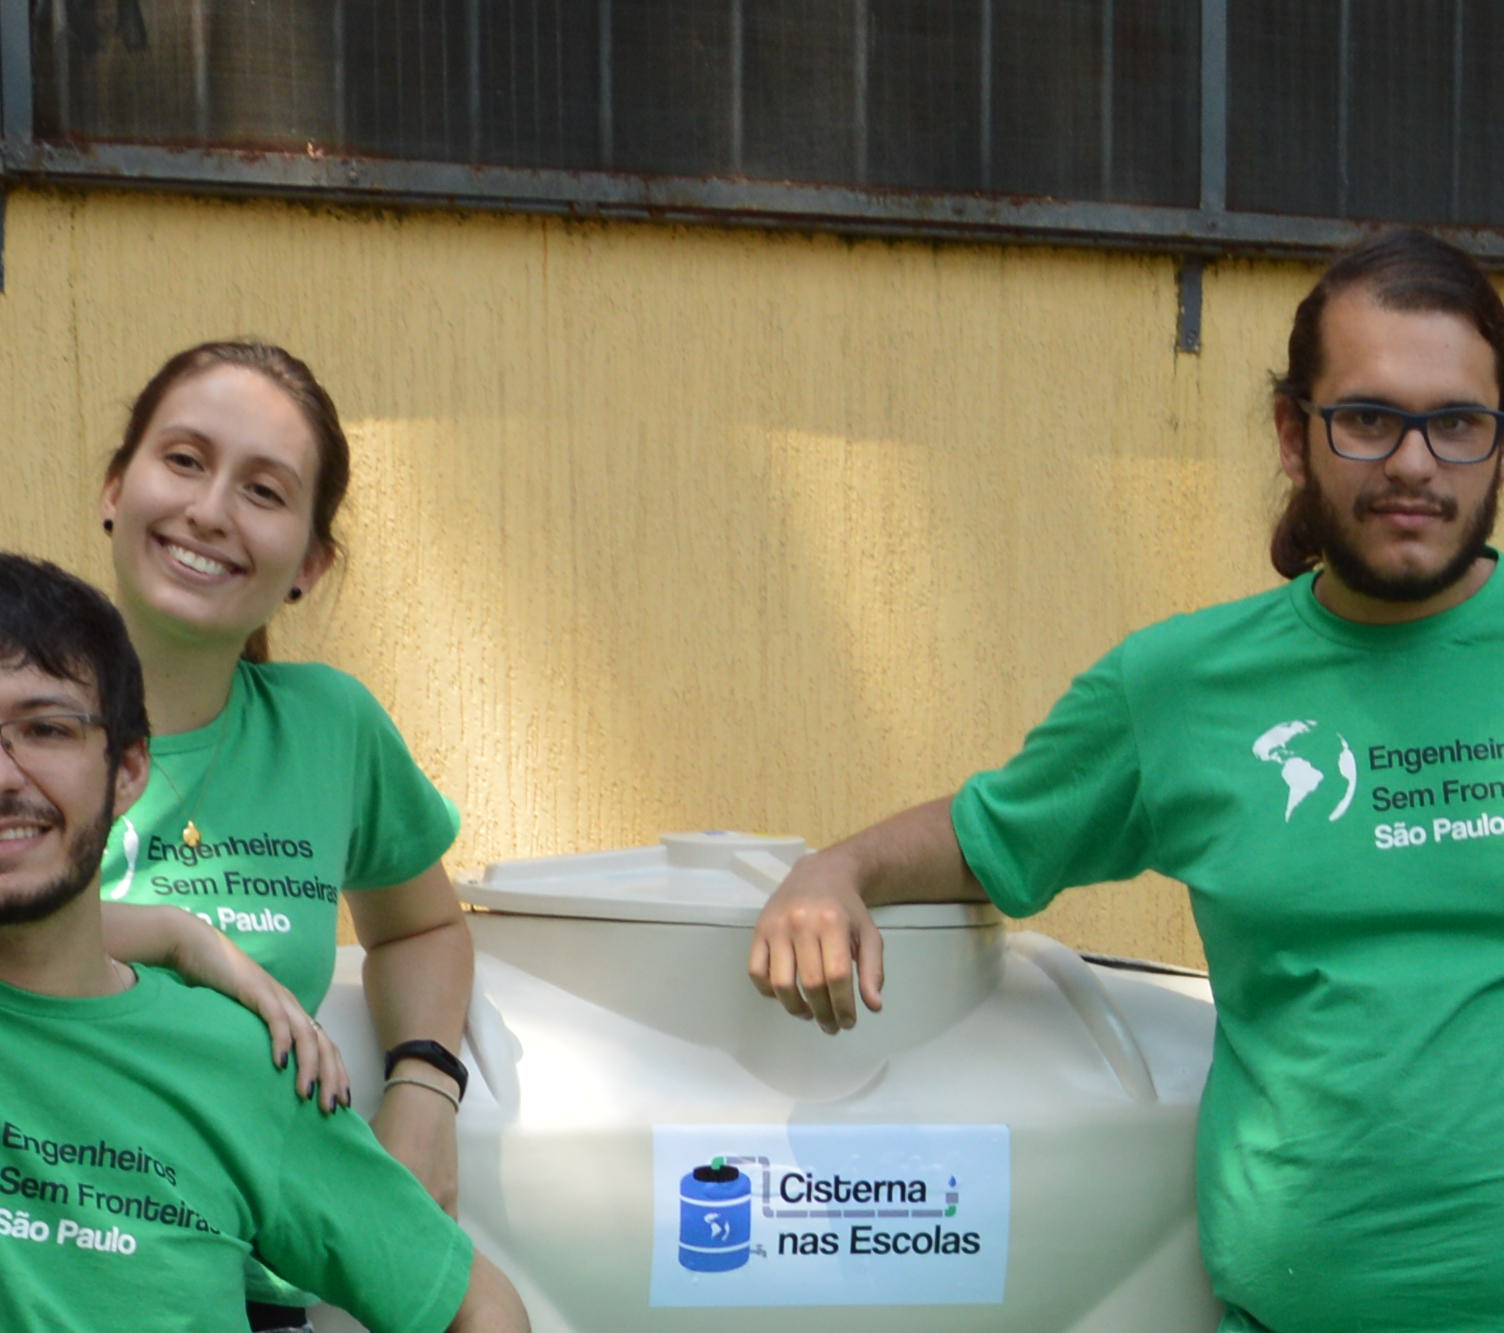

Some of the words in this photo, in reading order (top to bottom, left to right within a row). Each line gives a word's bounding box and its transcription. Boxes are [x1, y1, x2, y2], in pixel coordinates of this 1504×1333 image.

[1371, 785, 1435, 812] Sem
[147, 833, 314, 869] Engenheiros
[1374, 821, 1427, 850] São
[150, 875, 218, 897] Sem
[216, 906, 291, 933] Paulo
[1, 1121, 177, 1187] Engenheiros
[779, 1173, 927, 1204] Cisterna
[56, 1219, 138, 1256] Paulo
[778, 1229, 840, 1256] nas
[849, 1224, 982, 1256] Escolas
